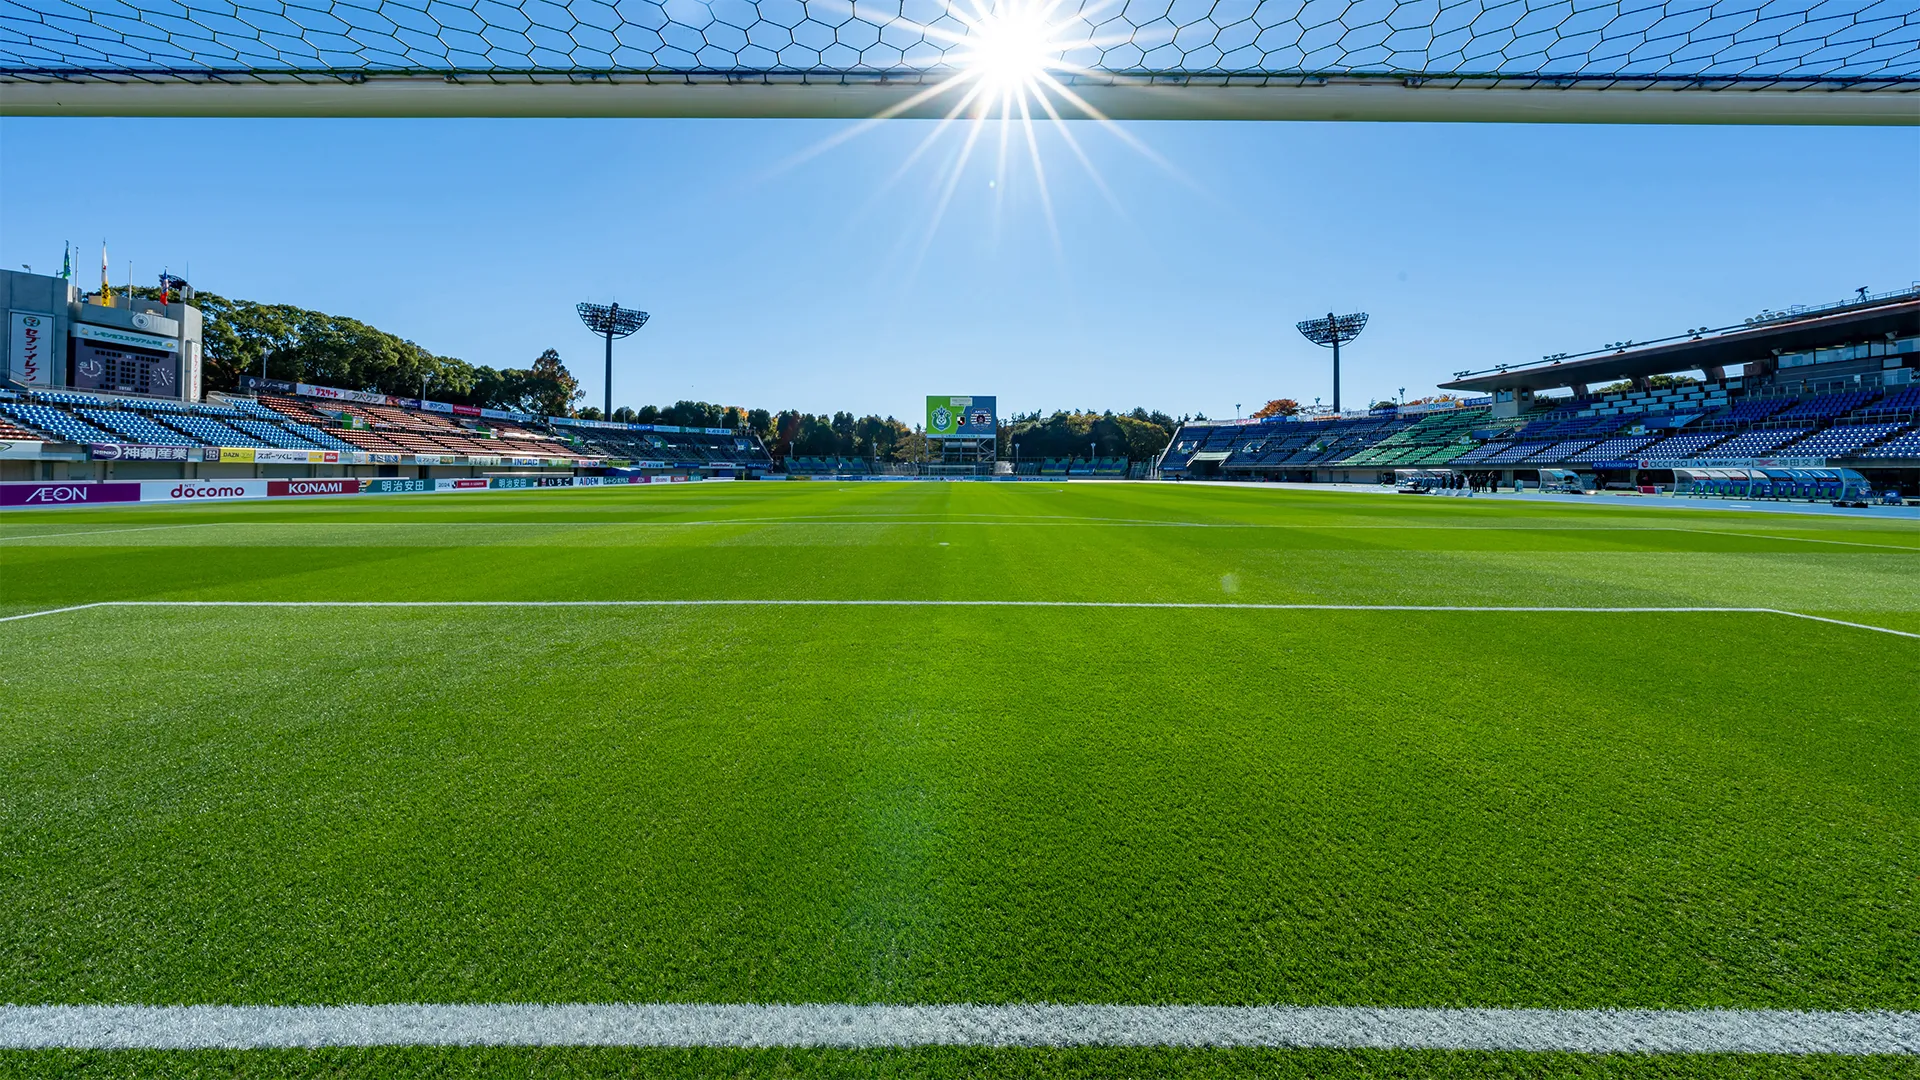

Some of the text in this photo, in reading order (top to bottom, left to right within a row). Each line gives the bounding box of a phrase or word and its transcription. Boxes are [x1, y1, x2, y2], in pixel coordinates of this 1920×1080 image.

[123, 446, 187, 459] 神鋼産業
[257, 452, 292, 460] スポーツくじ
[1650, 460, 1688, 468] accrea
[1779, 458, 1824, 467] 神田交通
[382, 480, 423, 491] 明治安田
[499, 478, 526, 487] 明治安田
[548, 478, 570, 486] いちご
[171, 484, 244, 498] docomo
[288, 482, 343, 494] KONAMI
